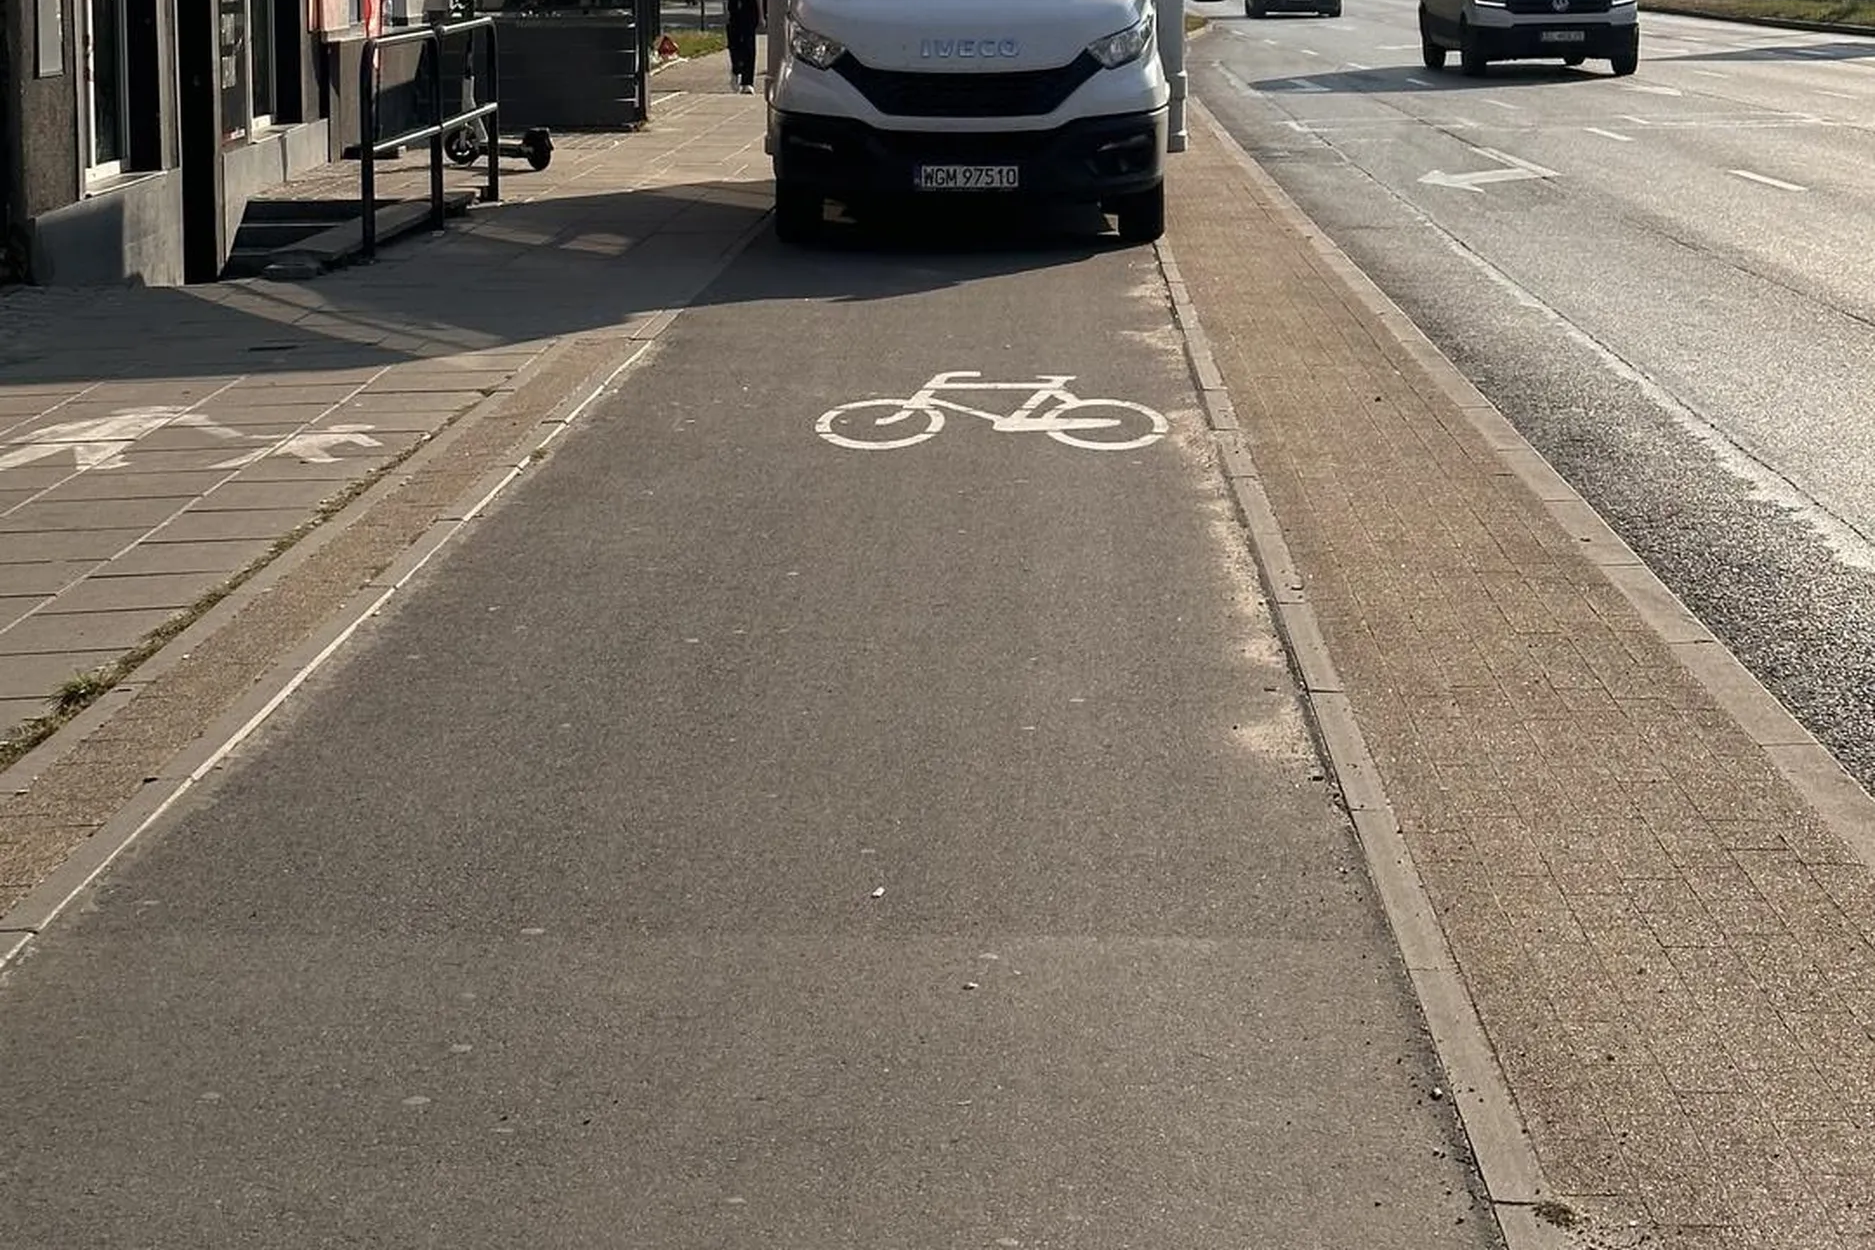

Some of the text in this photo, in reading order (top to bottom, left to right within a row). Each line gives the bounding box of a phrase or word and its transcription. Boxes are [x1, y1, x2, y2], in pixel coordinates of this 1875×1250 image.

[920, 39, 1020, 58] IVECO
[923, 167, 1018, 186] WGM 97510
